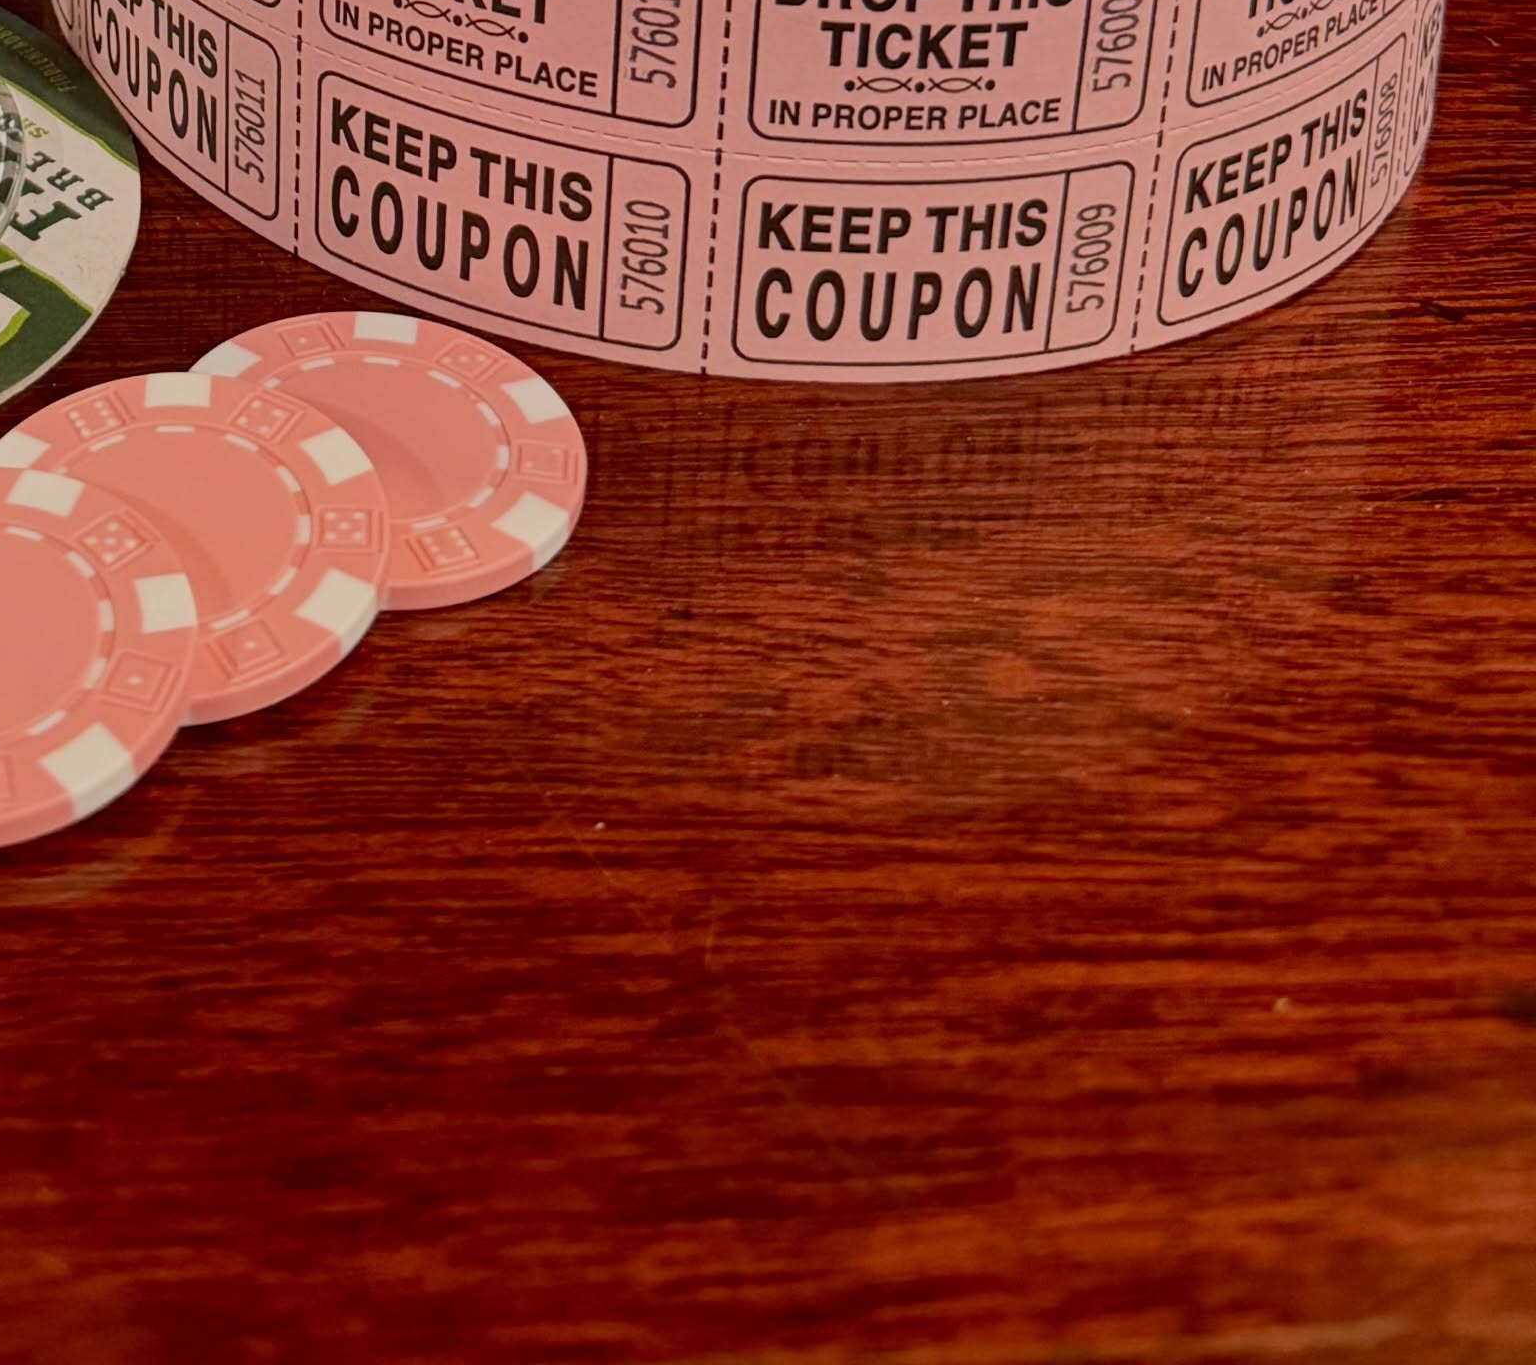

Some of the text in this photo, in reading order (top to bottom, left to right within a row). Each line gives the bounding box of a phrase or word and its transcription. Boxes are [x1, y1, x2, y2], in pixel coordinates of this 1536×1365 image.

[368, 11, 486, 71] PROPER
[494, 50, 598, 98] PLACE
[821, 20, 1028, 70] TICKET
[1201, 62, 1226, 91] IN
[1232, 26, 1319, 83] PROPER
[234, 69, 265, 183] 576011
[331, 97, 593, 222] KEEP THIS
[768, 98, 1062, 131] IN PROPER PLACE
[1184, 133, 1292, 215] KEEP
[1301, 88, 1367, 168] THIS
[1370, 73, 1398, 189] 576008
[331, 164, 589, 311] COUPON
[619, 200, 670, 315] 576010
[758, 198, 1048, 254] KEEP THIS
[1066, 204, 1116, 314] 576009
[1177, 149, 1361, 298] COUPON
[755, 262, 1041, 342] COUPON
